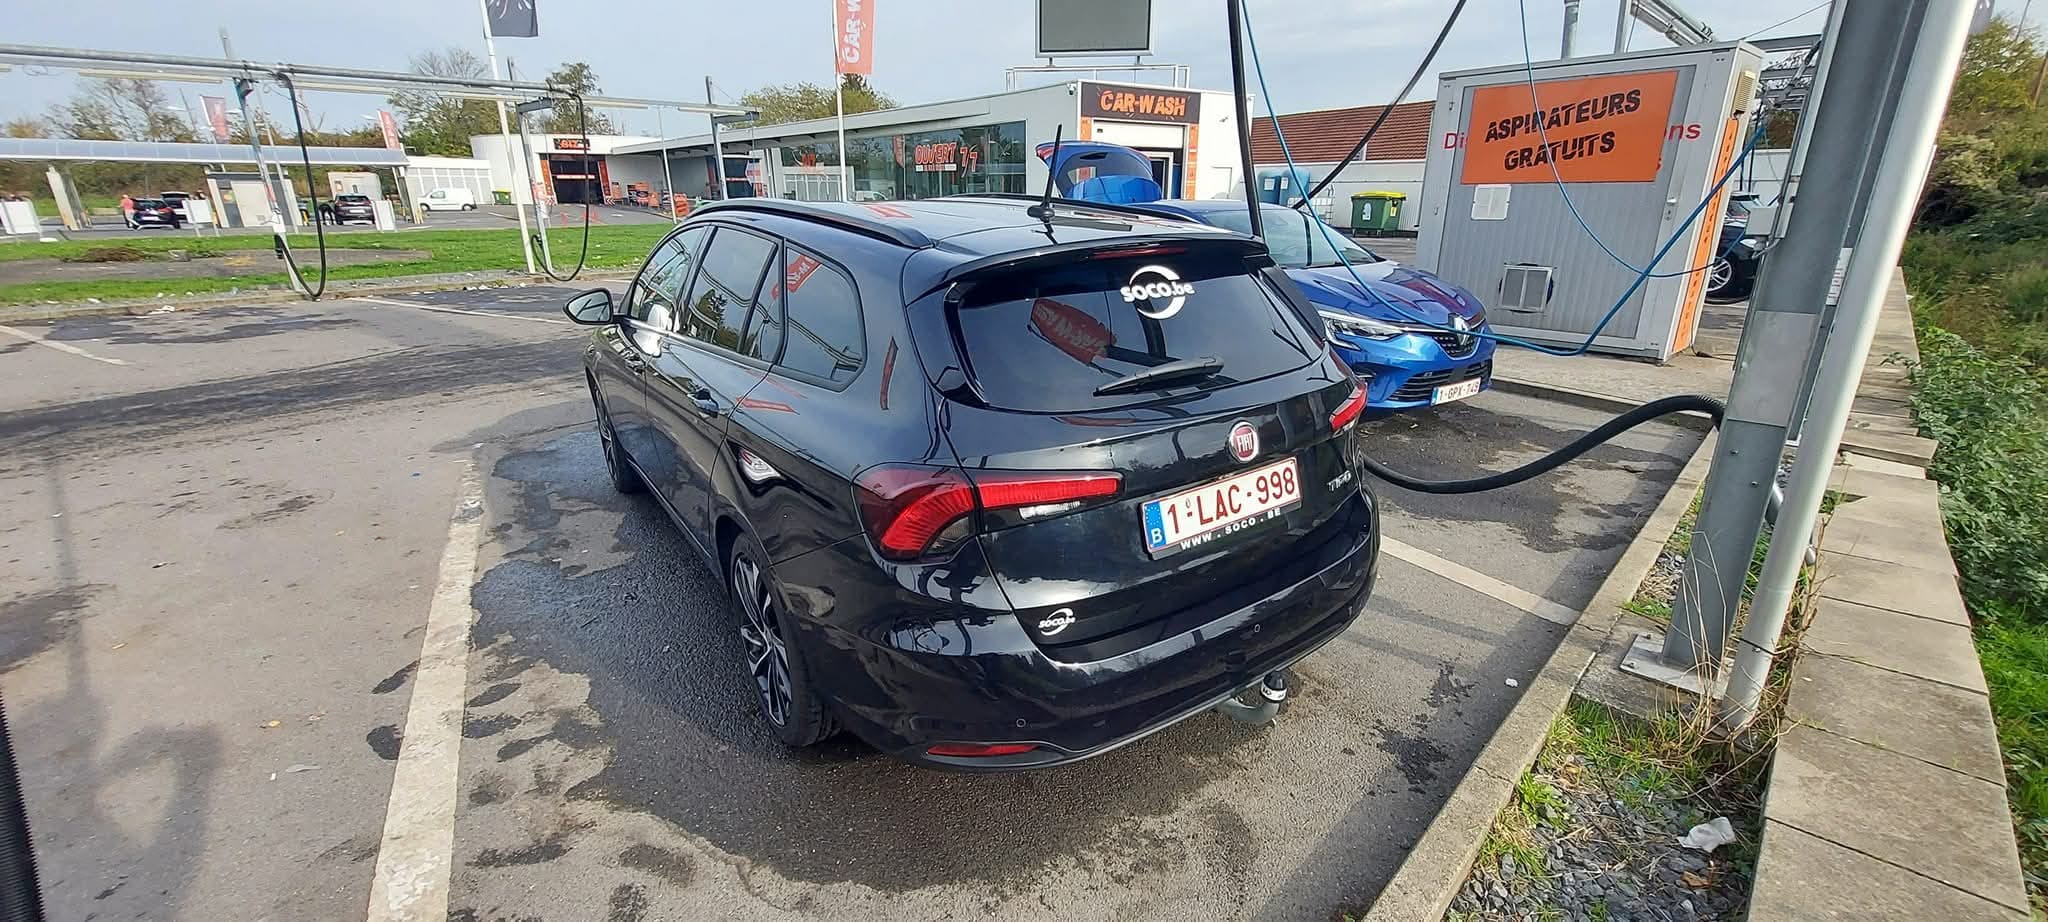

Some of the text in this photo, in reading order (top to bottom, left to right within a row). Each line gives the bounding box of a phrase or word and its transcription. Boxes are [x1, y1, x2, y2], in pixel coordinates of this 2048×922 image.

[1100, 91, 1186, 116] CAR-WASH
[1485, 88, 1641, 143] ASPIRATEURS
[1444, 132, 1468, 149] Di
[1664, 124, 1702, 140] ns
[915, 142, 957, 164] OUVERT
[1504, 131, 1616, 171] GRATUITS
[1120, 280, 1195, 303] SOCO.be
[1236, 432, 1254, 453] FIAT
[1151, 527, 1163, 544] B
